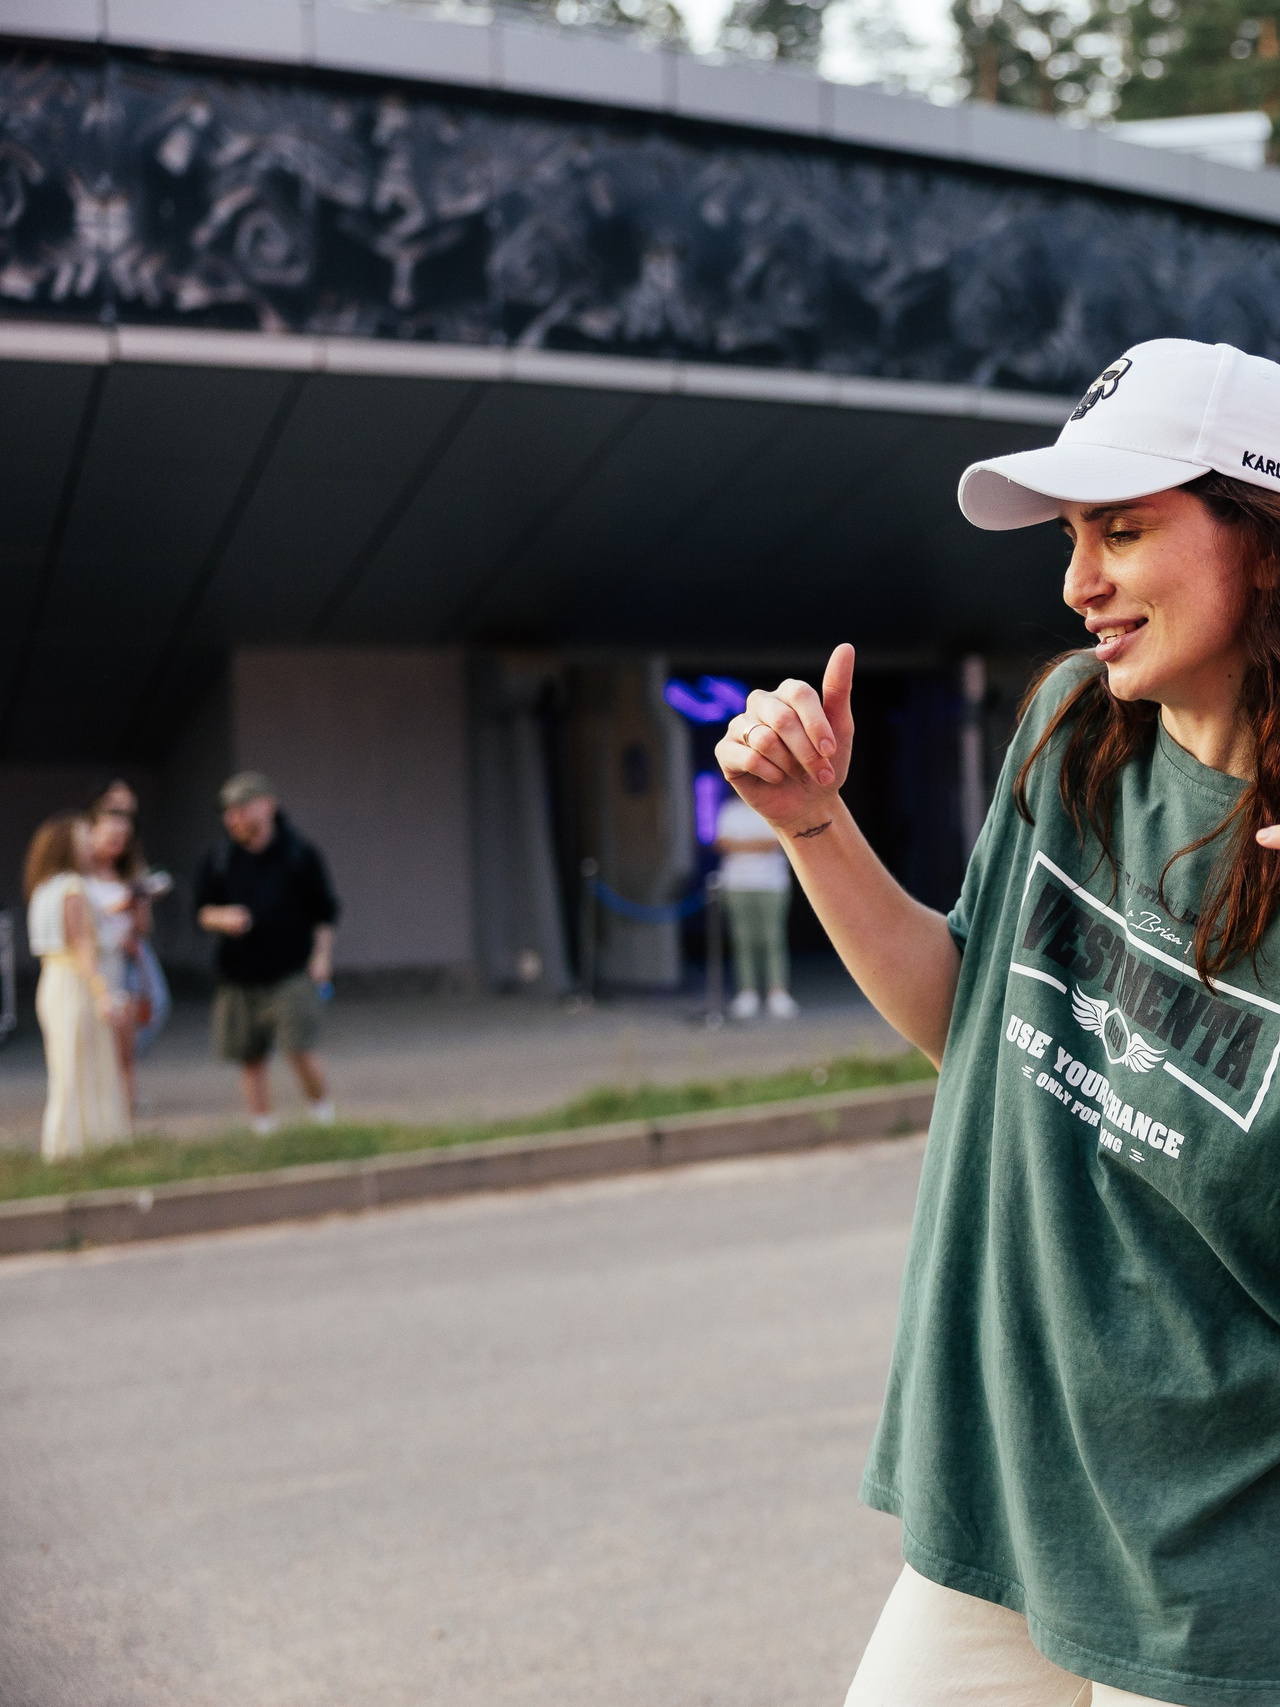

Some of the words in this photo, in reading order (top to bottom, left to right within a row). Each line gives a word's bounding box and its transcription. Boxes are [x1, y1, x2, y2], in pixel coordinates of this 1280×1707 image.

[1005, 1014, 1053, 1059] USE
[1053, 1045, 1110, 1106] YOUR
[1103, 1089, 1185, 1159] CHANCE
[1035, 1072, 1073, 1106] ONLY
[1070, 1100, 1101, 1127] FOR
